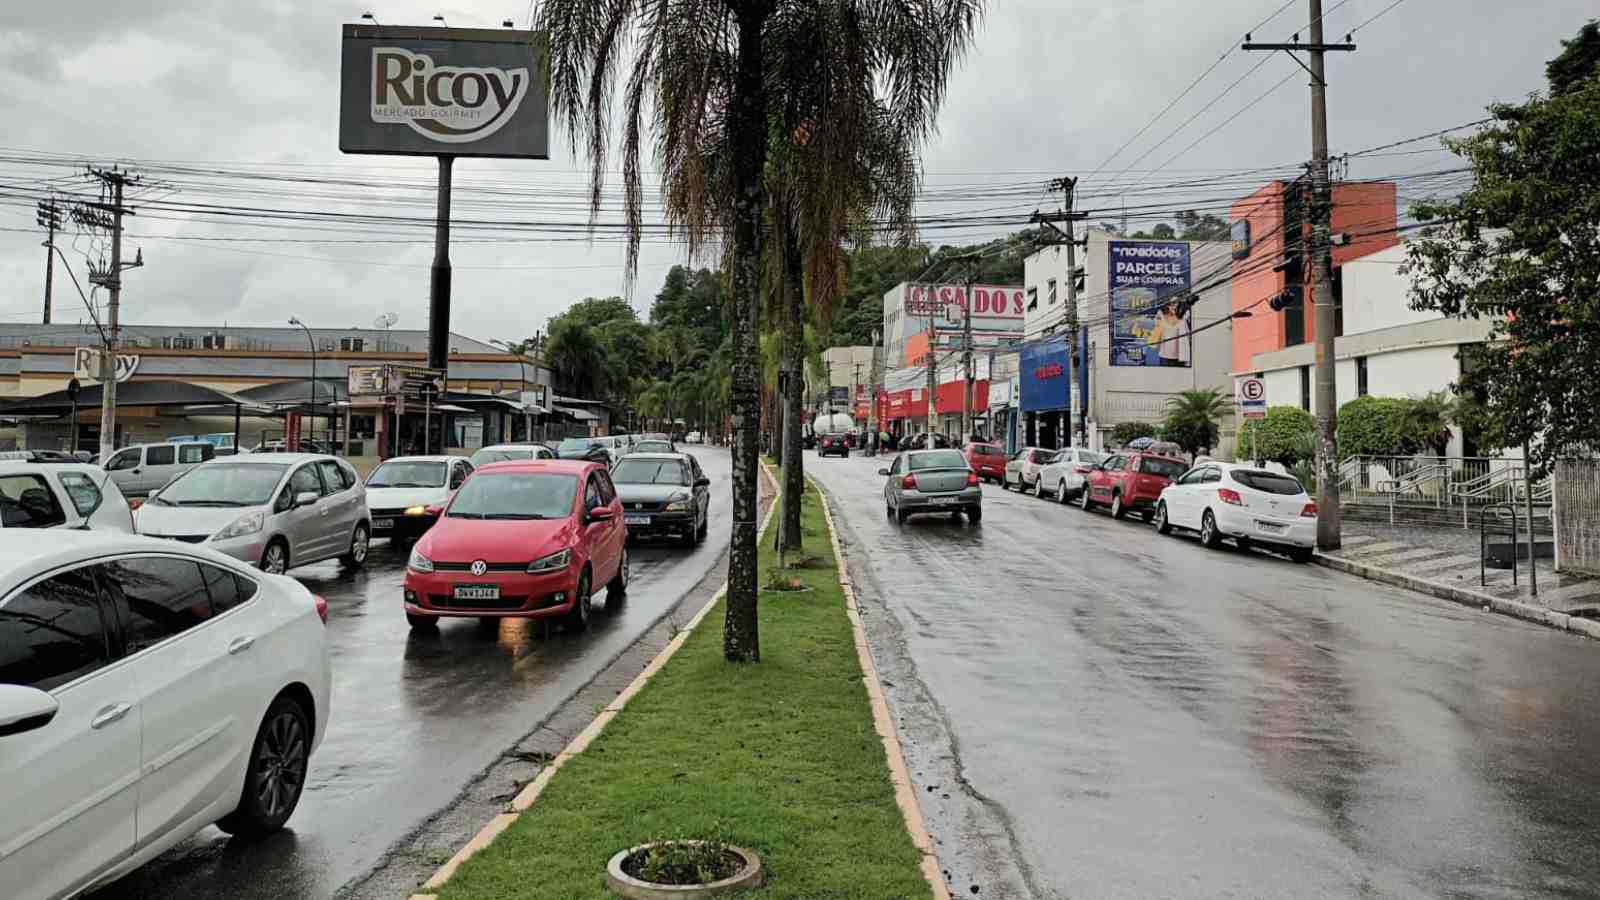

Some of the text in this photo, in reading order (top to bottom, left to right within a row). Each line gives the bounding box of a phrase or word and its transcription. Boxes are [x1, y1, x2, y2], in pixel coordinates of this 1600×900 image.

[375, 53, 520, 134] Ricoy
[374, 106, 481, 119] MERCADO GOURMET
[1116, 262, 1181, 274] PARCELE
[975, 289, 1008, 314] DO
[1248, 383, 1257, 396] E
